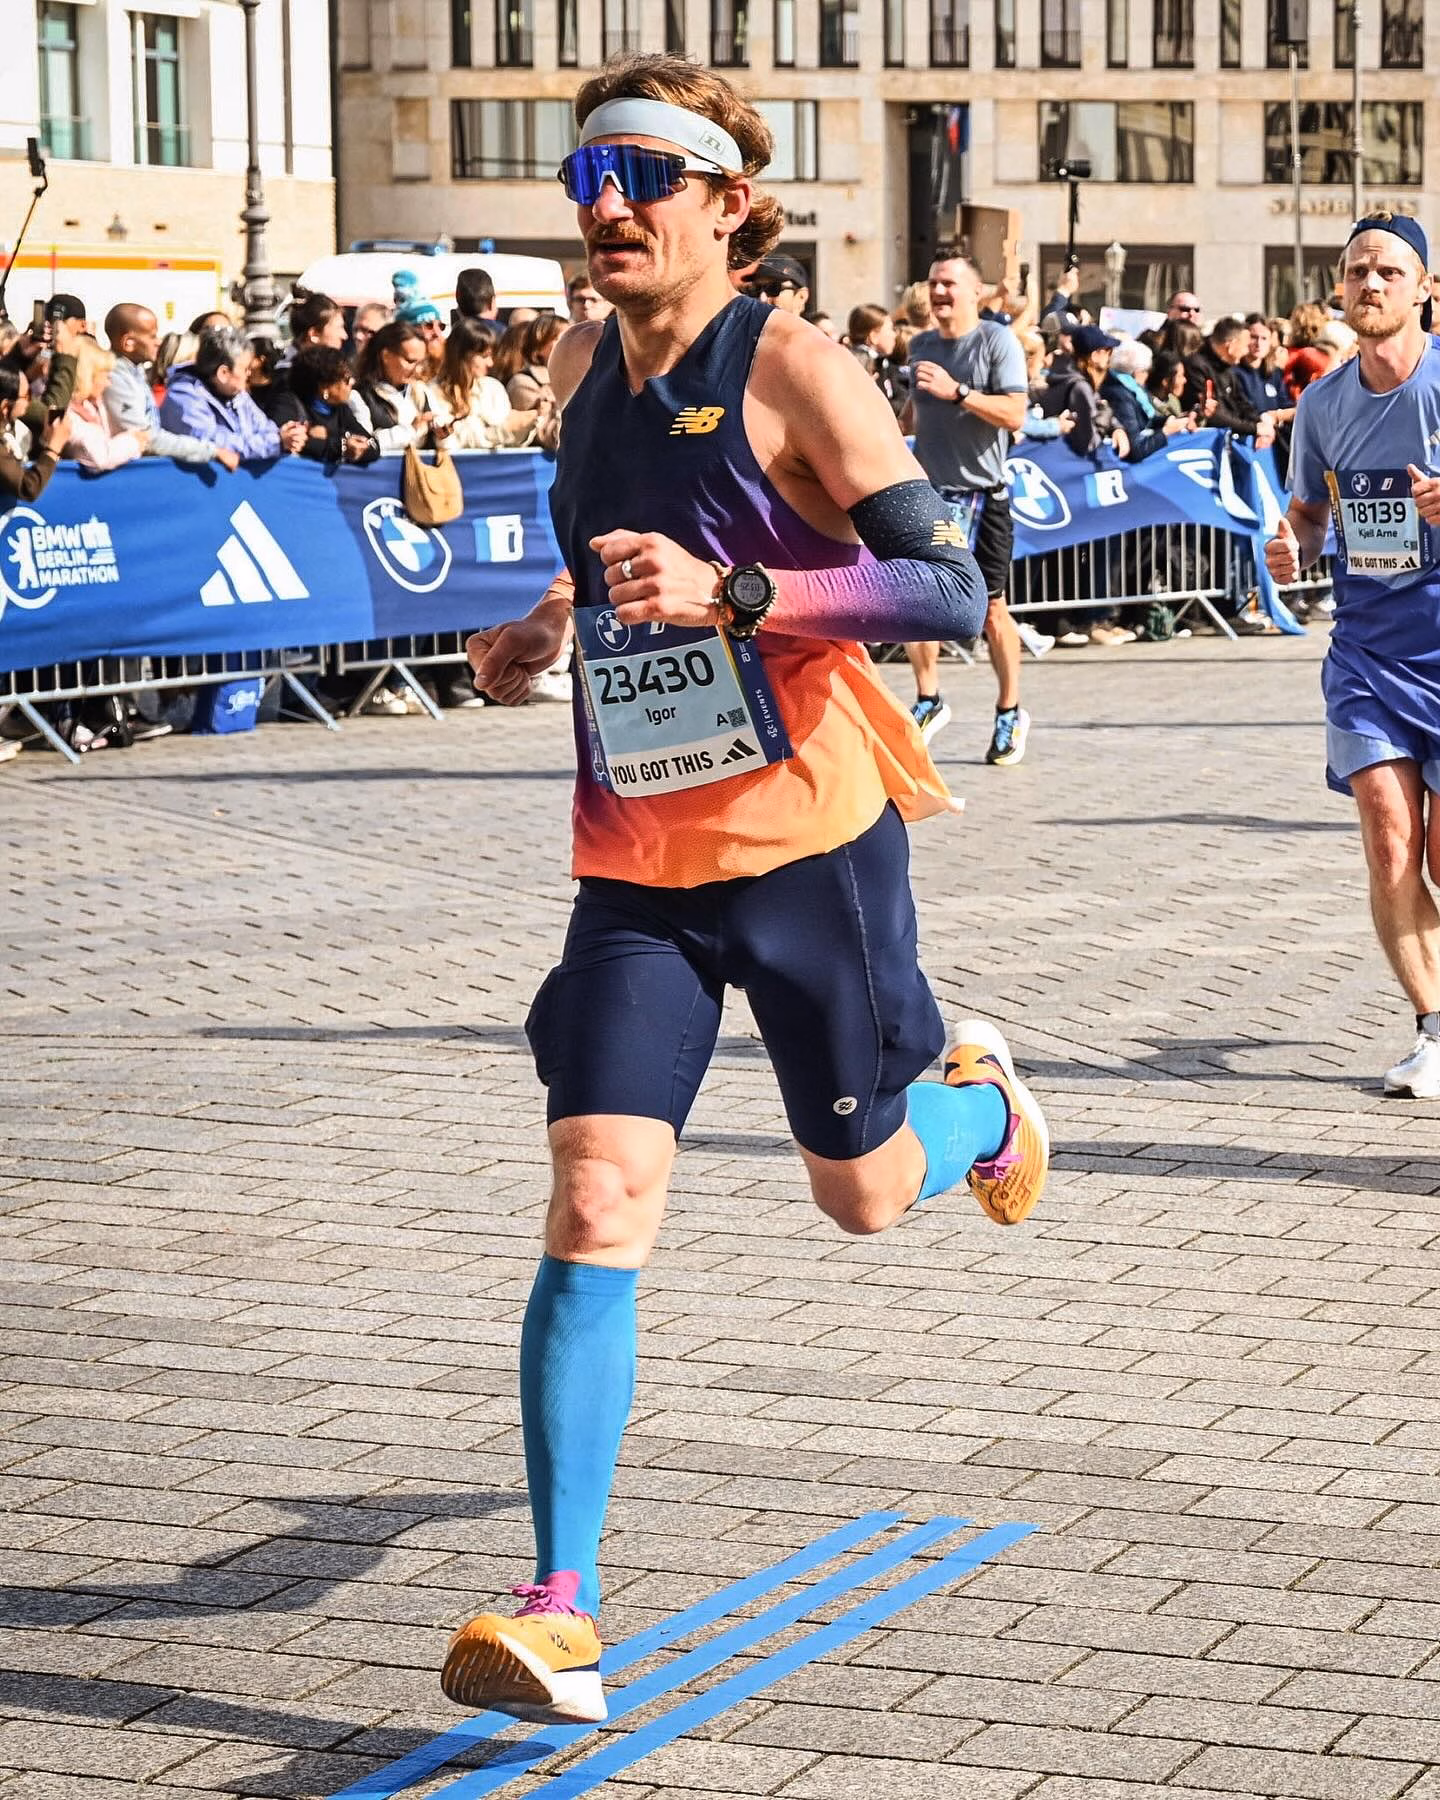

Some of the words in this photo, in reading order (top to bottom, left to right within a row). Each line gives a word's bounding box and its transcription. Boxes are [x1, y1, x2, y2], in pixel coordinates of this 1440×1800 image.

[1347, 501, 1407, 524] 18139
[31, 523, 82, 551] BMW
[1376, 528, 1398, 538] Arne
[35, 548, 88, 569] BERLIN
[1350, 556, 1363, 568] YOU
[1364, 556, 1378, 568] GOT
[1378, 556, 1398, 569] THIS
[38, 564, 120, 588] MARATHON
[593, 649, 716, 706] 23430
[645, 705, 677, 726] Igor
[715, 713, 729, 727] A
[610, 764, 638, 785] YOU
[639, 759, 671, 782] GOT
[671, 750, 715, 777] THIS
